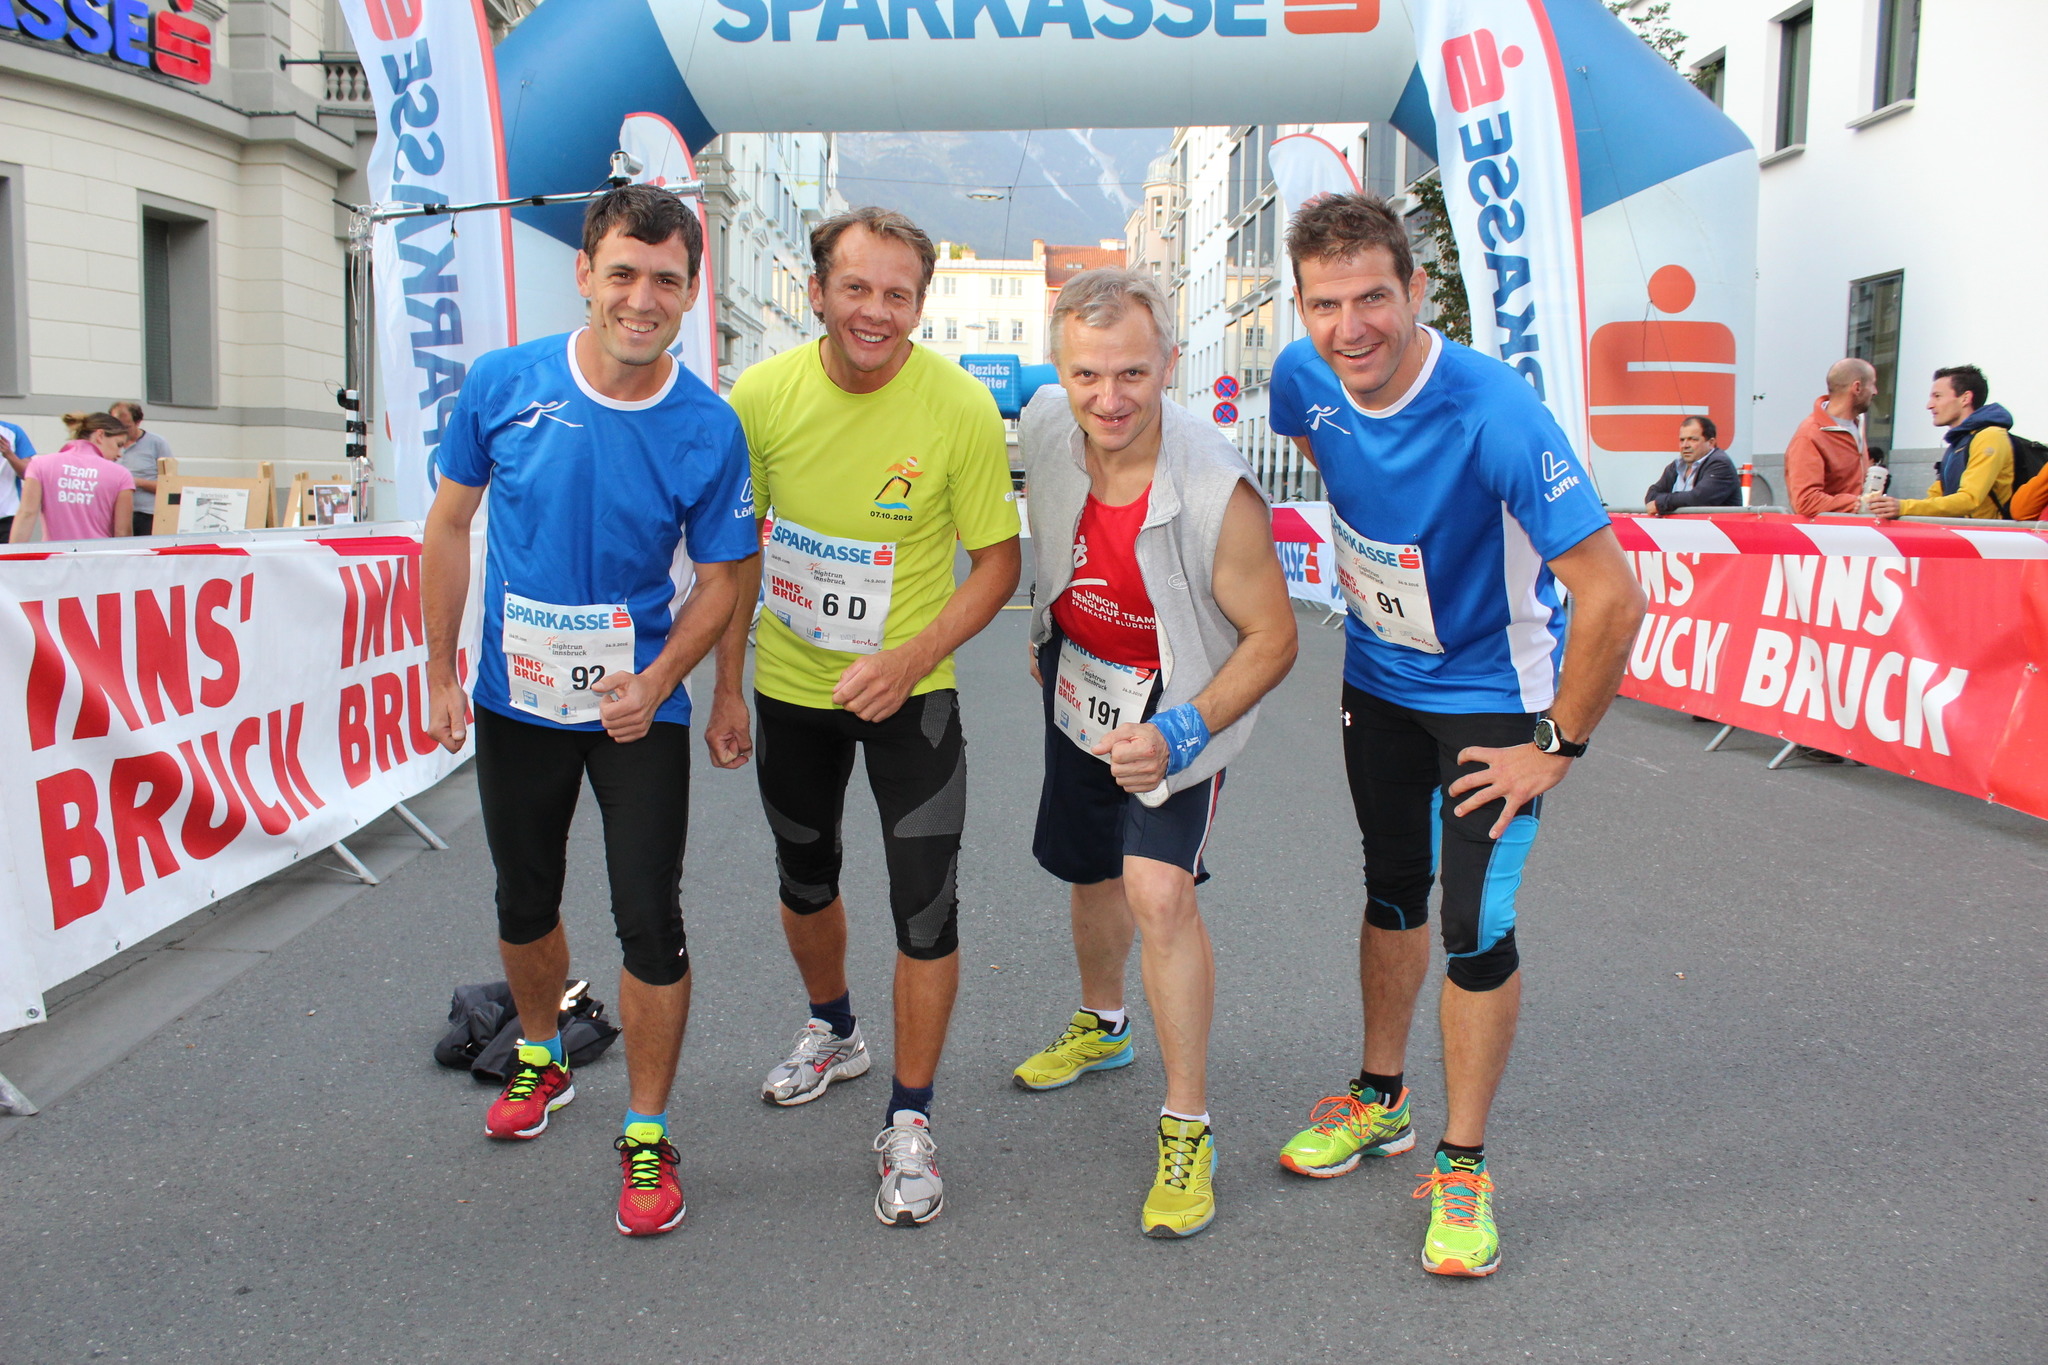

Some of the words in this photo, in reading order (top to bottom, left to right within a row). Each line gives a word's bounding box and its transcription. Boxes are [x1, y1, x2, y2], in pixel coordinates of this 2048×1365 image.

[968, 363, 1010, 376] Bezirks
[58, 477, 98, 492] GIRLY
[62, 464, 98, 479] TEAM
[58, 490, 94, 504] BOAT
[772, 525, 872, 565] SPARKASSE
[813, 575, 846, 585] innsbruck
[814, 569, 843, 579] nightrun
[772, 585, 813, 610] BRUCK
[1085, 590, 1119, 610] UNION
[1339, 575, 1367, 603] BRUCK
[338, 555, 424, 670] INN
[506, 602, 610, 631] SPARKASSE
[822, 593, 839, 617] 6
[848, 596, 867, 620] D
[1072, 590, 1119, 617] BERGLAUF
[1122, 612, 1155, 624] TEAM
[1072, 599, 1112, 622] SPARKASSE
[1376, 592, 1405, 618] 91
[1624, 613, 1730, 695] UCK
[514, 666, 555, 688] BRUCK
[571, 665, 606, 691] 92
[1058, 685, 1081, 711] BRUCK
[1740, 628, 1969, 757] BRUCK
[1088, 696, 1120, 730] 191
[36, 701, 325, 931] BRUCK
